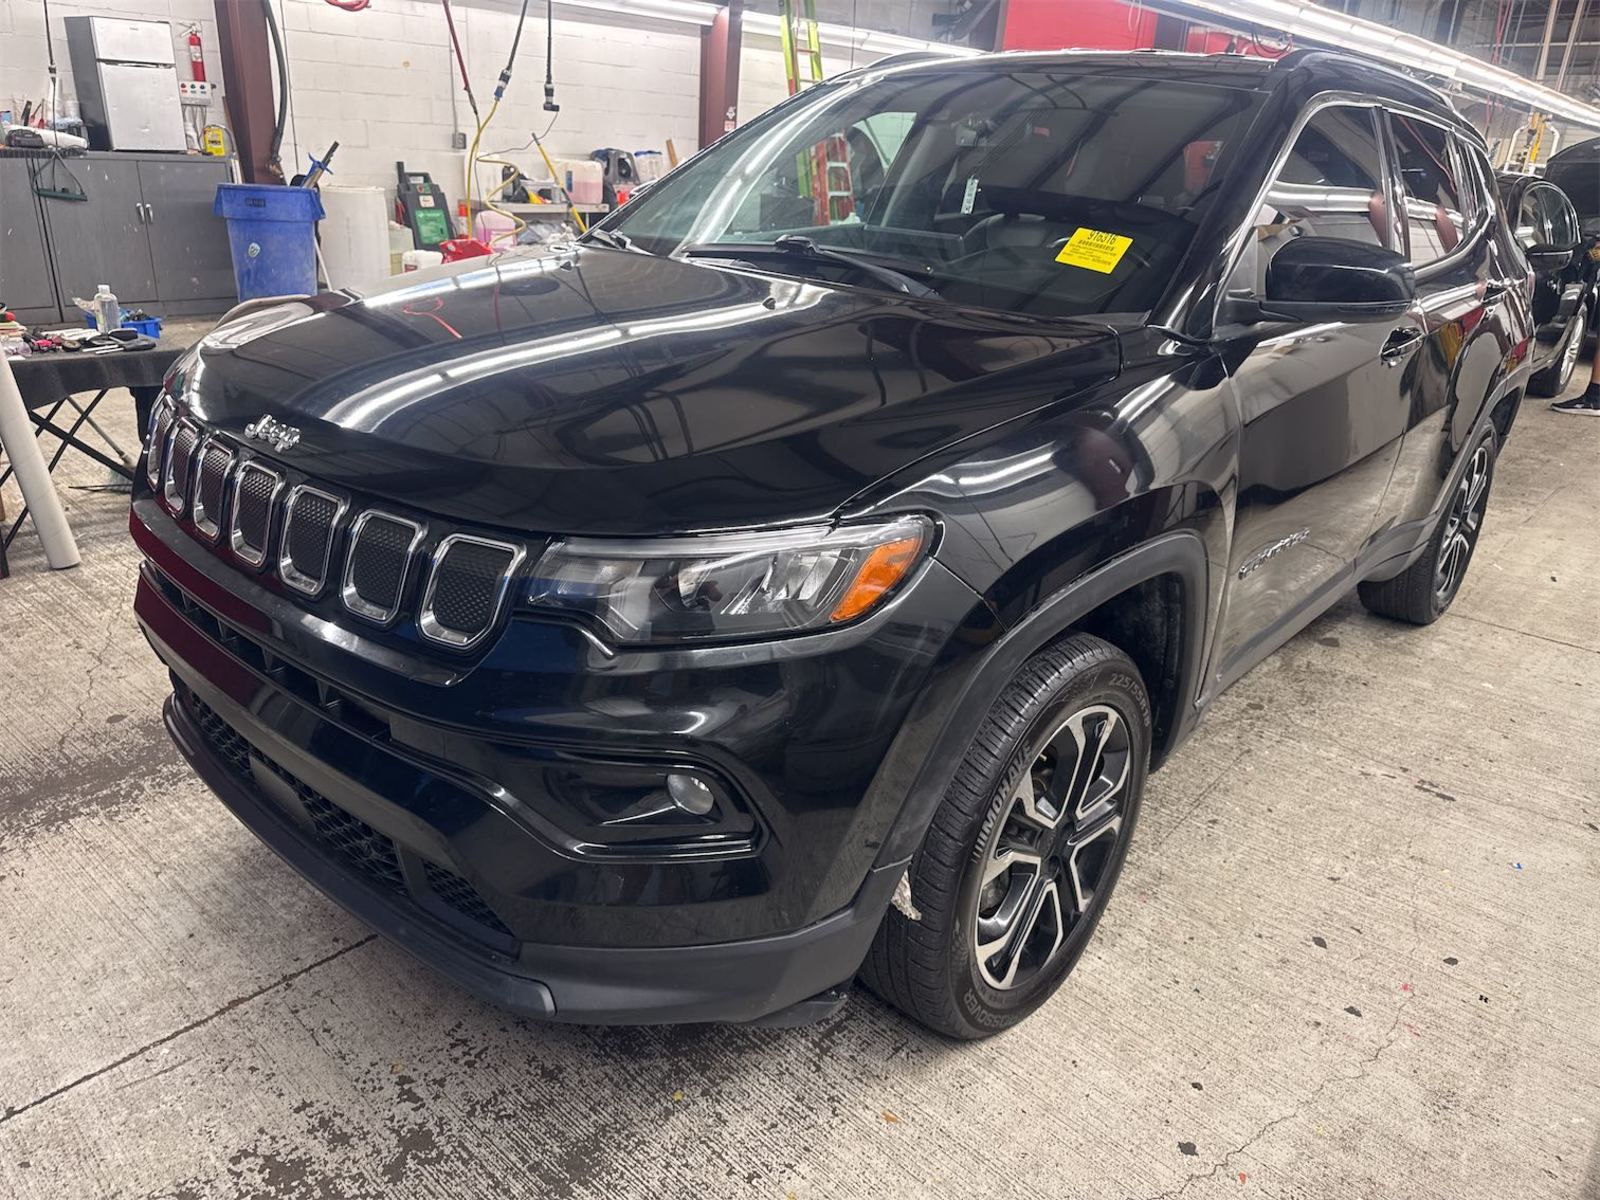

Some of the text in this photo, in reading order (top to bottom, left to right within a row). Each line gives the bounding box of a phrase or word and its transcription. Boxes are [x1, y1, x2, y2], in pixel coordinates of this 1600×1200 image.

[244, 414, 301, 453] Jeep
[984, 740, 1032, 835] MOHAVE
[963, 988, 1022, 1028] ROSSOVER
